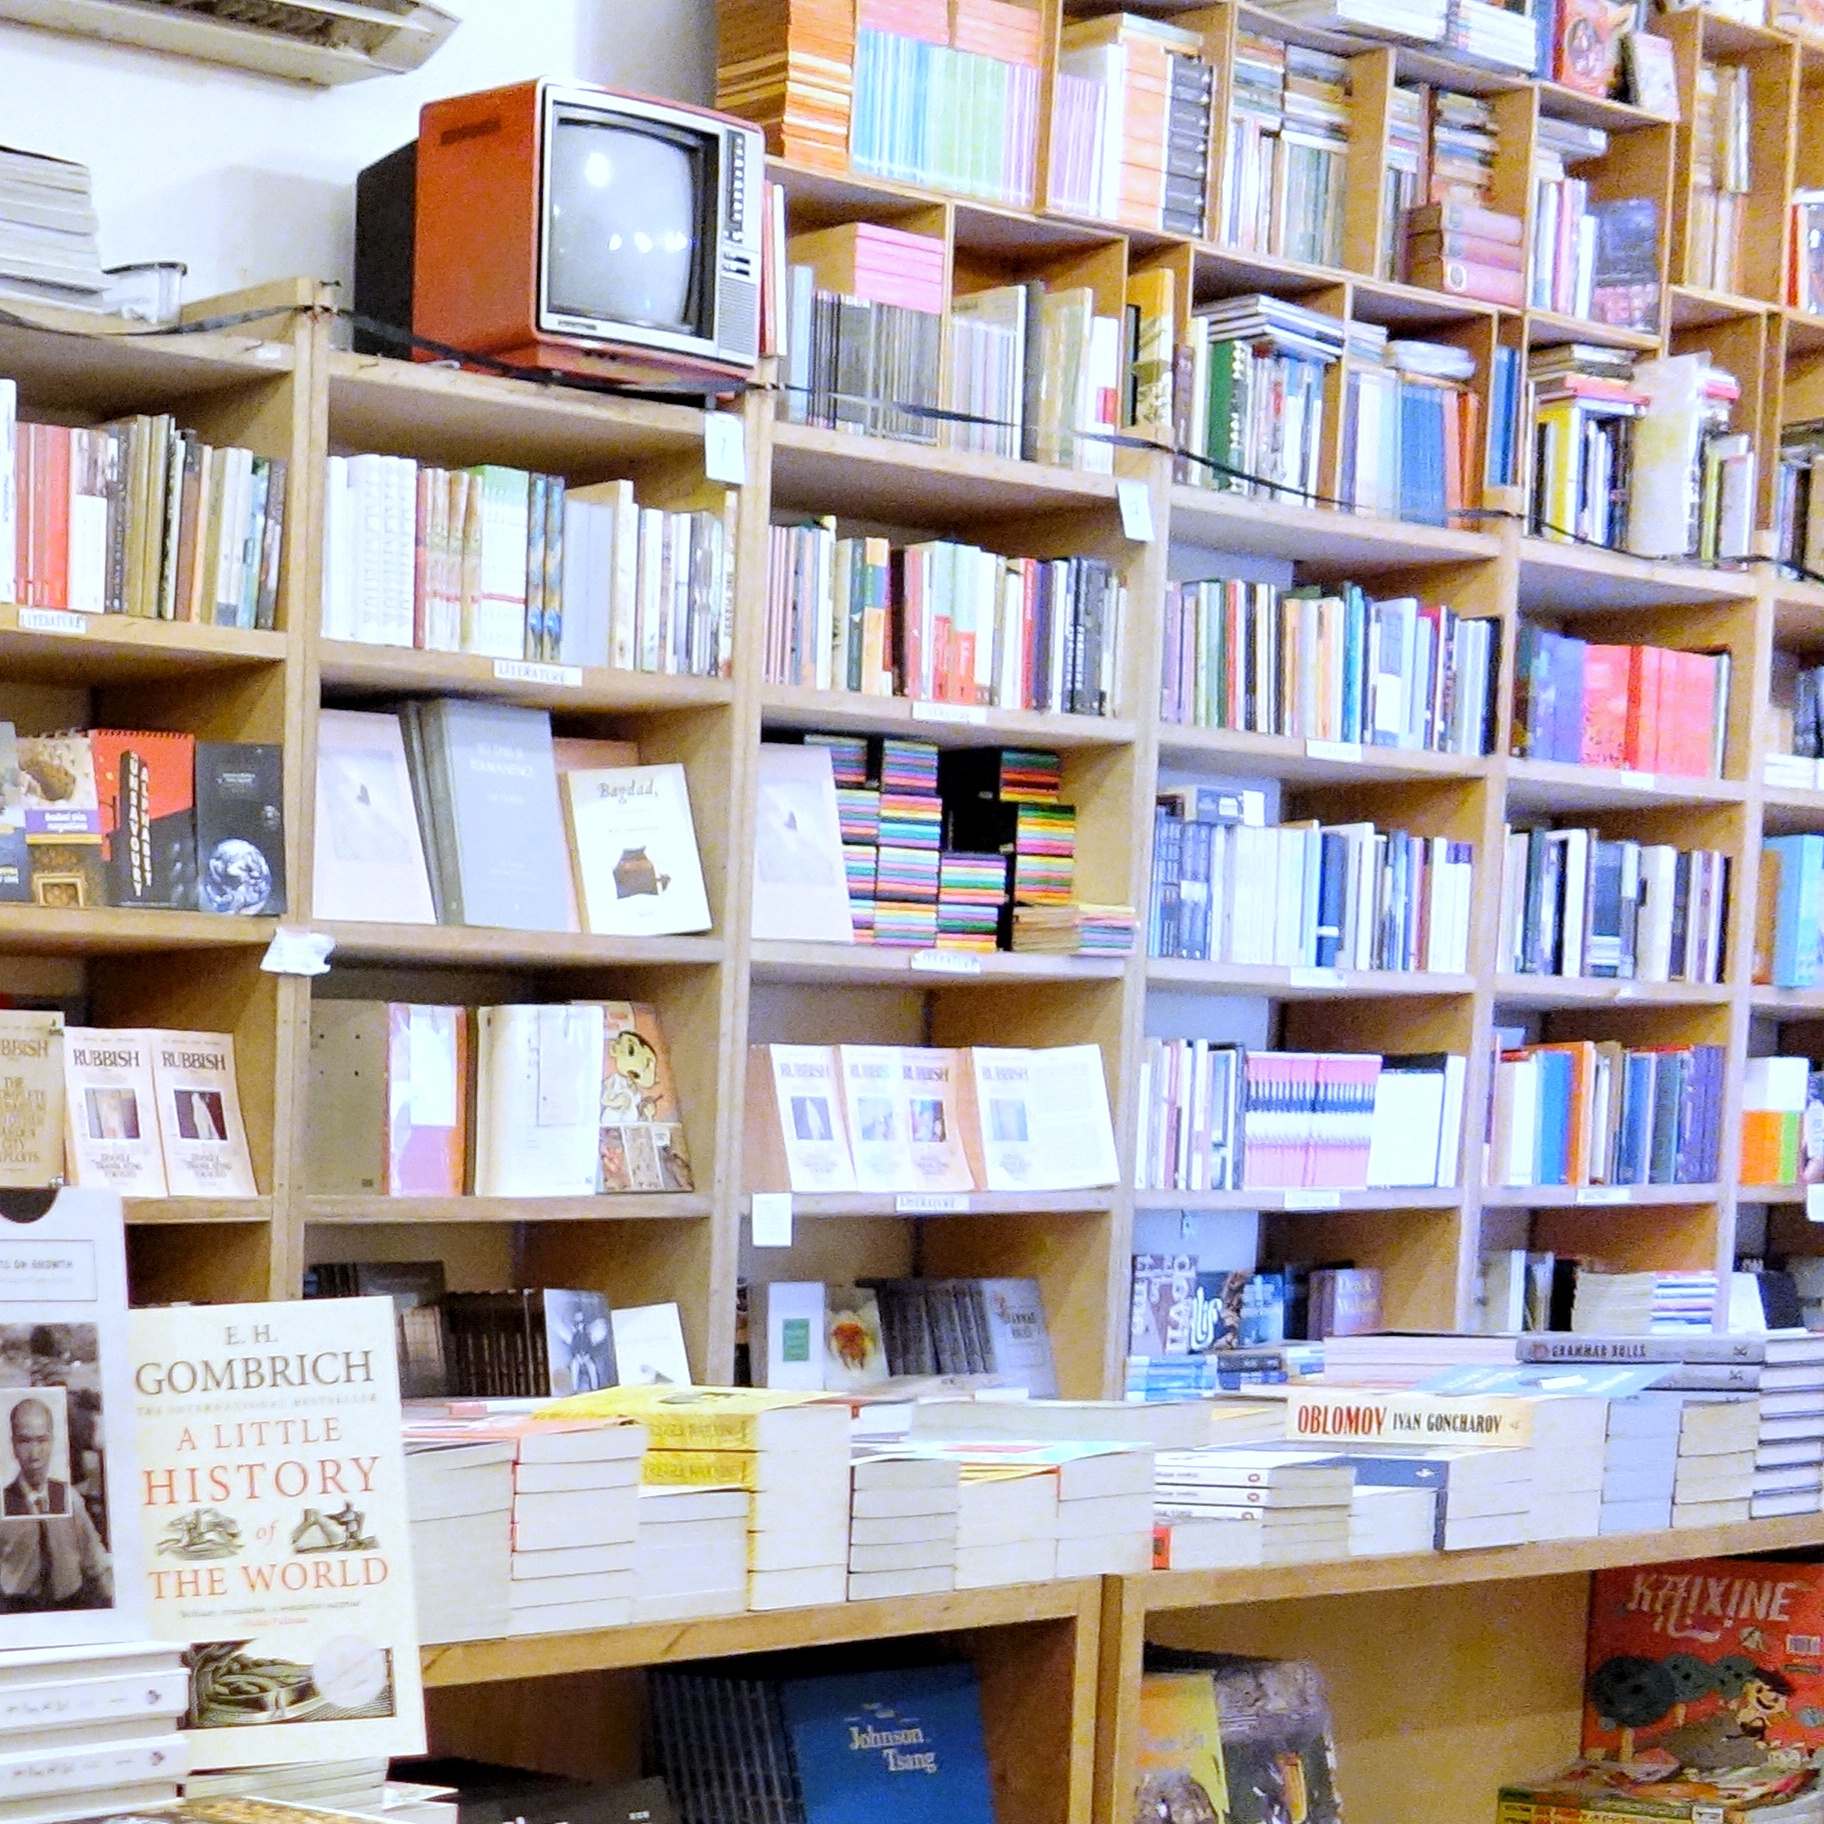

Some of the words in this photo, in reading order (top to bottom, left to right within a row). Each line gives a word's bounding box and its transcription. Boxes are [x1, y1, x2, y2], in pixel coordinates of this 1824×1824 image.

[73, 1049, 141, 1068] RUBBISH
[161, 1050, 227, 1071] RUBBISH
[224, 1324, 247, 1345] E.
[253, 1323, 279, 1343] H.
[1550, 1343, 1608, 1358] GRAMMAR
[135, 1349, 376, 1396] GOMBRICH
[176, 1426, 197, 1451] A
[213, 1415, 344, 1450] LITTLE
[1296, 1404, 1388, 1436] OBLOMOV
[1392, 1411, 1422, 1431] IVAN
[1426, 1412, 1503, 1434] GONCHAROV
[141, 1455, 381, 1507] HISTORY
[254, 1518, 281, 1544] of
[148, 1564, 230, 1600] THE
[241, 1556, 390, 1593] WORLD
[848, 1723, 926, 1752] Johnson
[882, 1748, 939, 1775] Tsang
